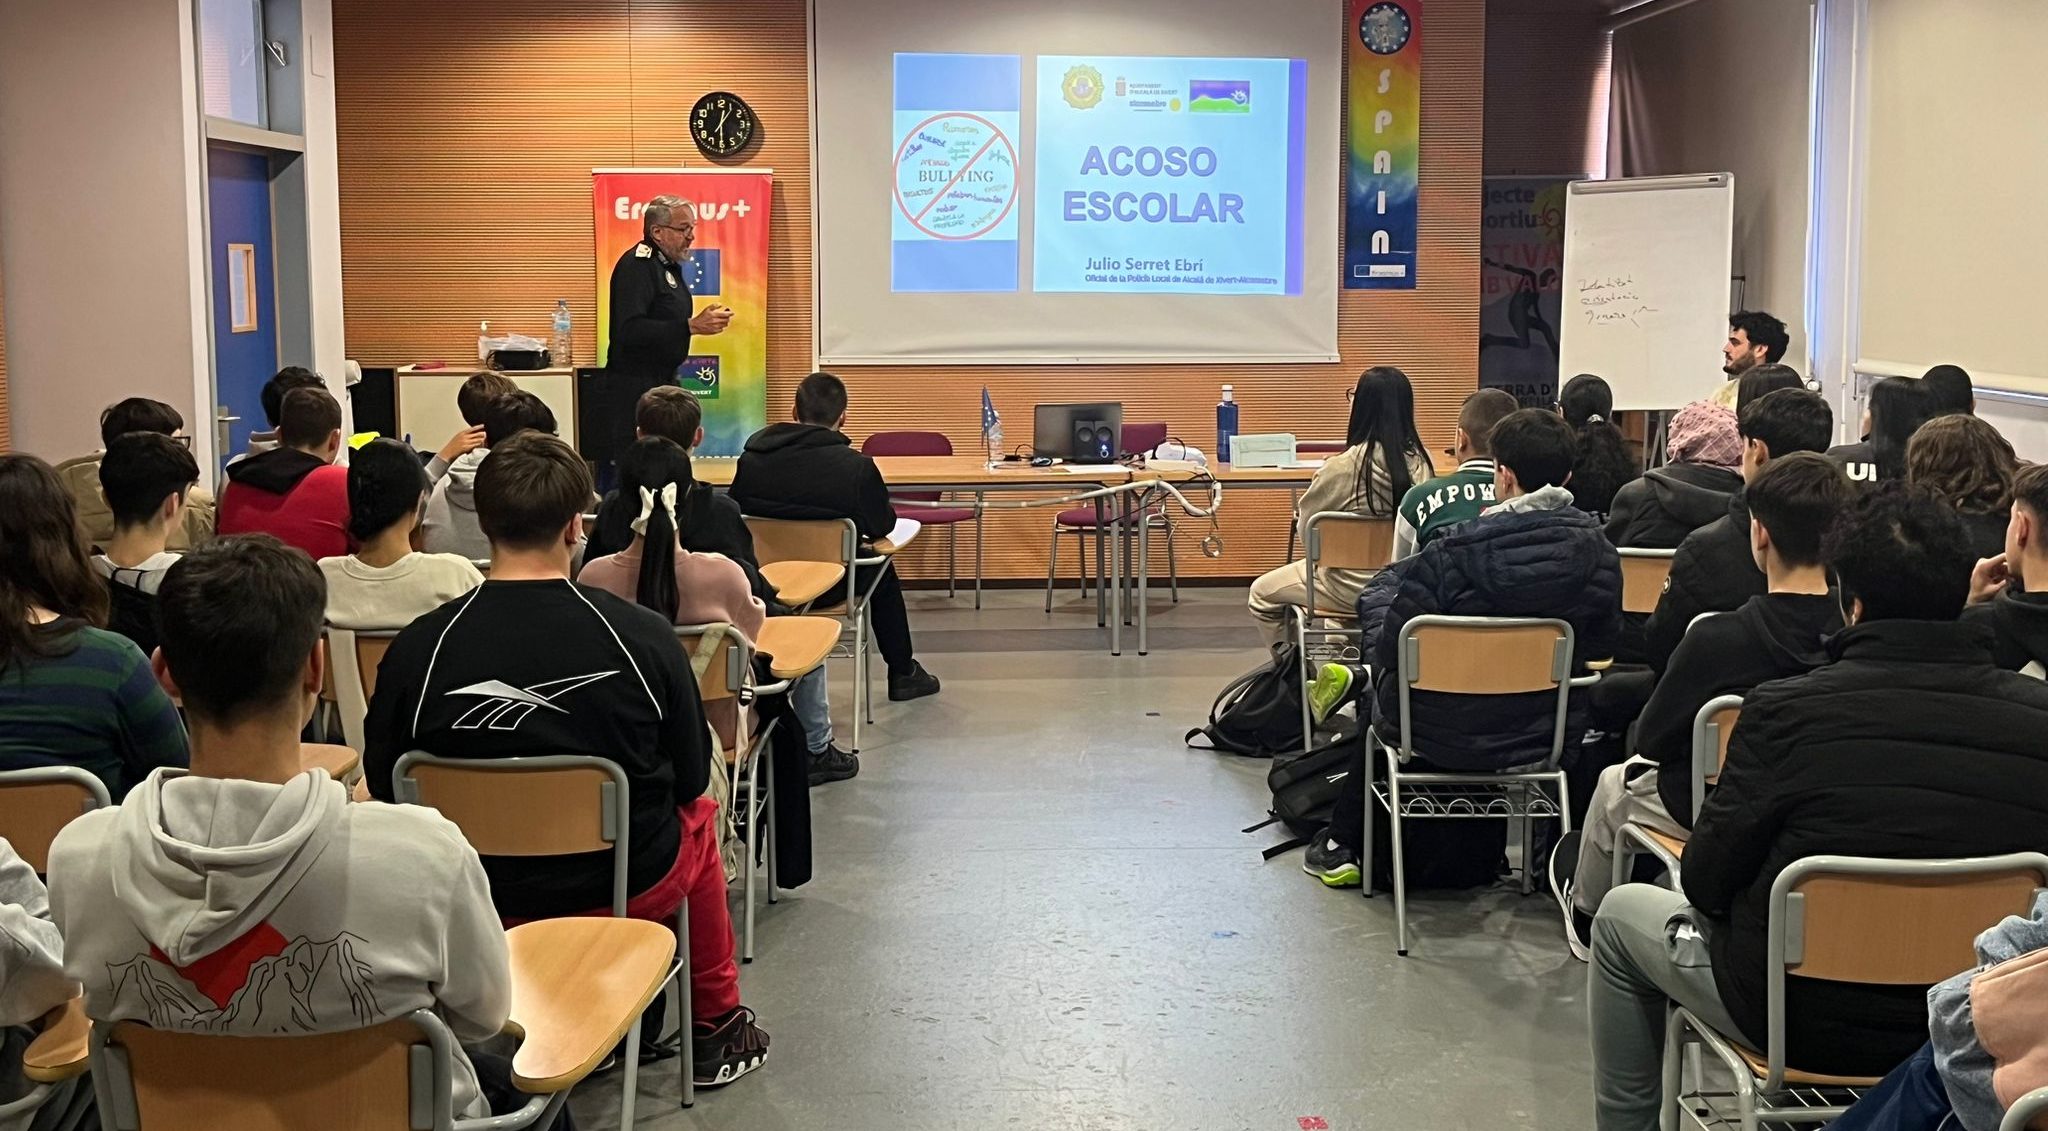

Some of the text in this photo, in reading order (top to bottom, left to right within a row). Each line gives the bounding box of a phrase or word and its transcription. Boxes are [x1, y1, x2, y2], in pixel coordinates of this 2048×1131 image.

[736, 109, 742, 118] 2
[697, 119, 704, 129] 9
[740, 120, 745, 129] 3
[701, 130, 707, 139] 8
[1080, 145, 1217, 177] ACOSO
[919, 170, 994, 183] BULLING
[615, 196, 751, 220] Erus+
[1063, 190, 1245, 224] ESCOLAR
[1085, 257, 1203, 272] Julio Serret Ebrí
[1085, 274, 1107, 282] Oficial
[1152, 275, 1171, 283] Local
